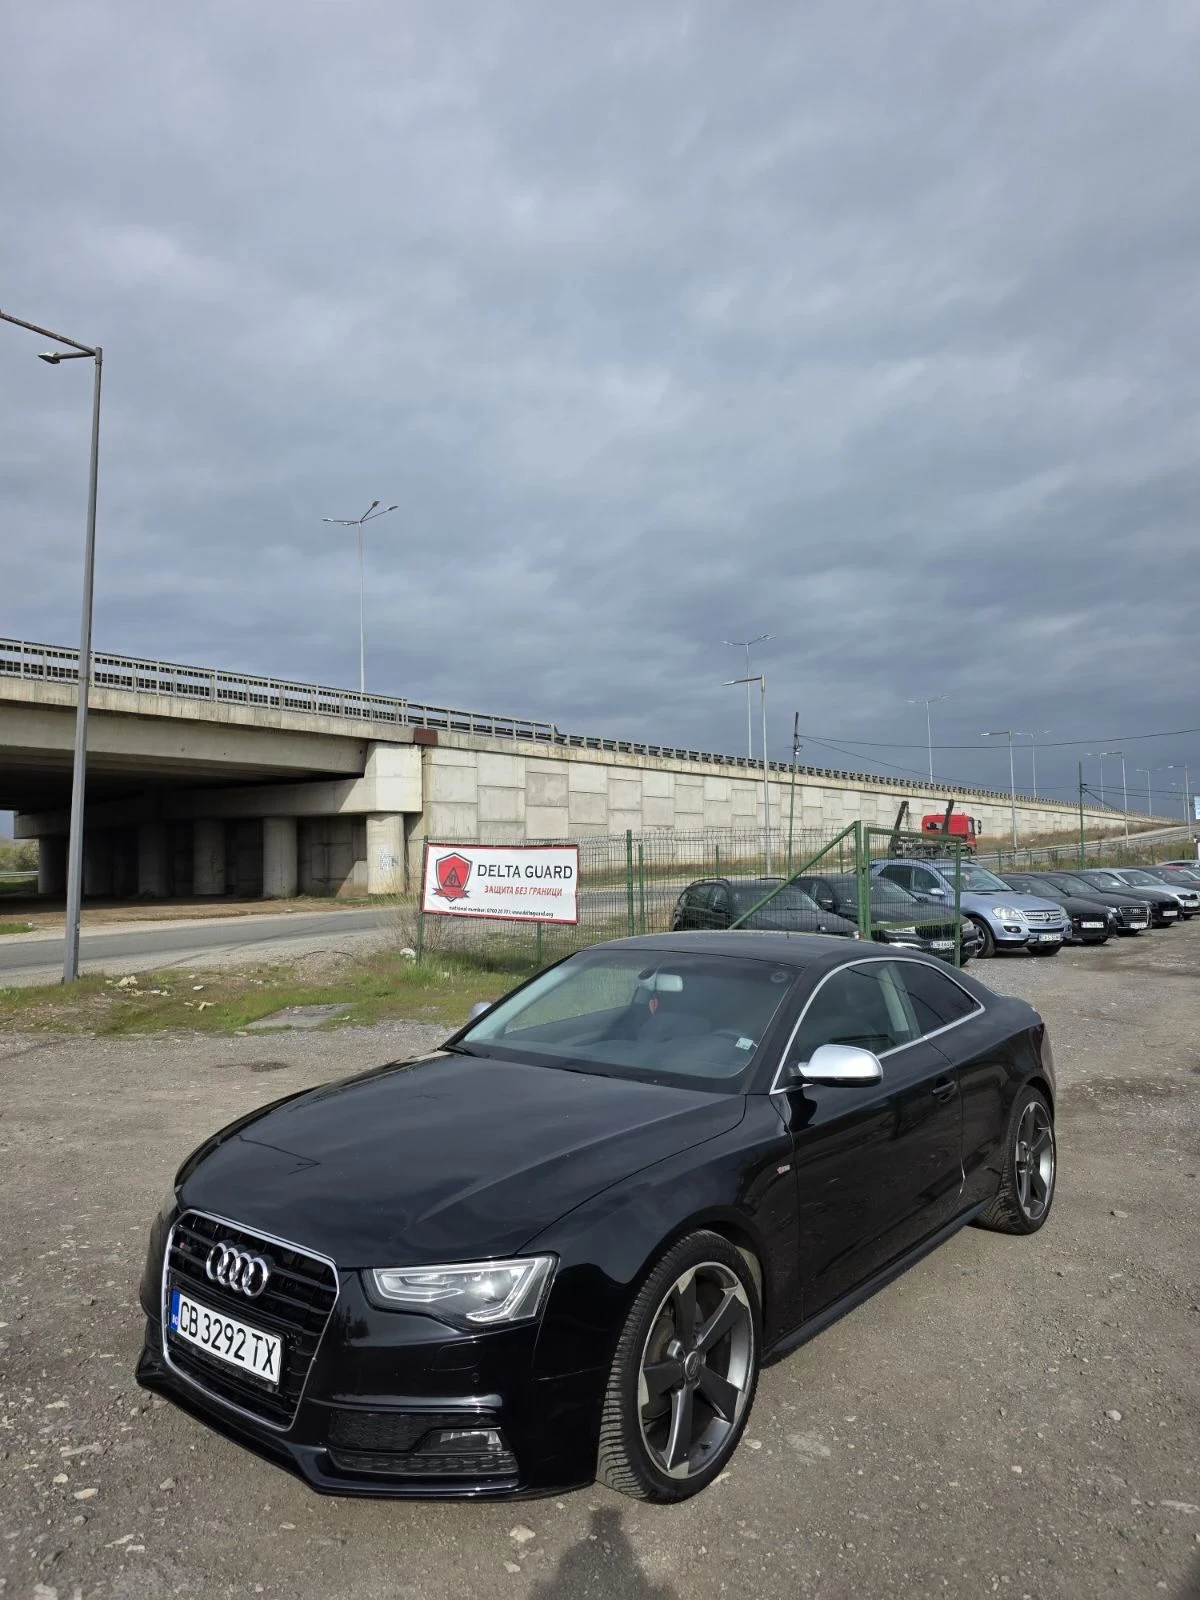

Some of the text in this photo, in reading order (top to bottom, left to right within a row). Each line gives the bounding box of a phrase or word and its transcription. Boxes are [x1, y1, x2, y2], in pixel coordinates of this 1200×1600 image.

[477, 864, 573, 880] DELTA GUARD
[484, 885, 563, 898] ЗАЩИТА БЕЗ ГРАНИЦИ
[180, 1301, 277, 1375] CB 3292 TX
